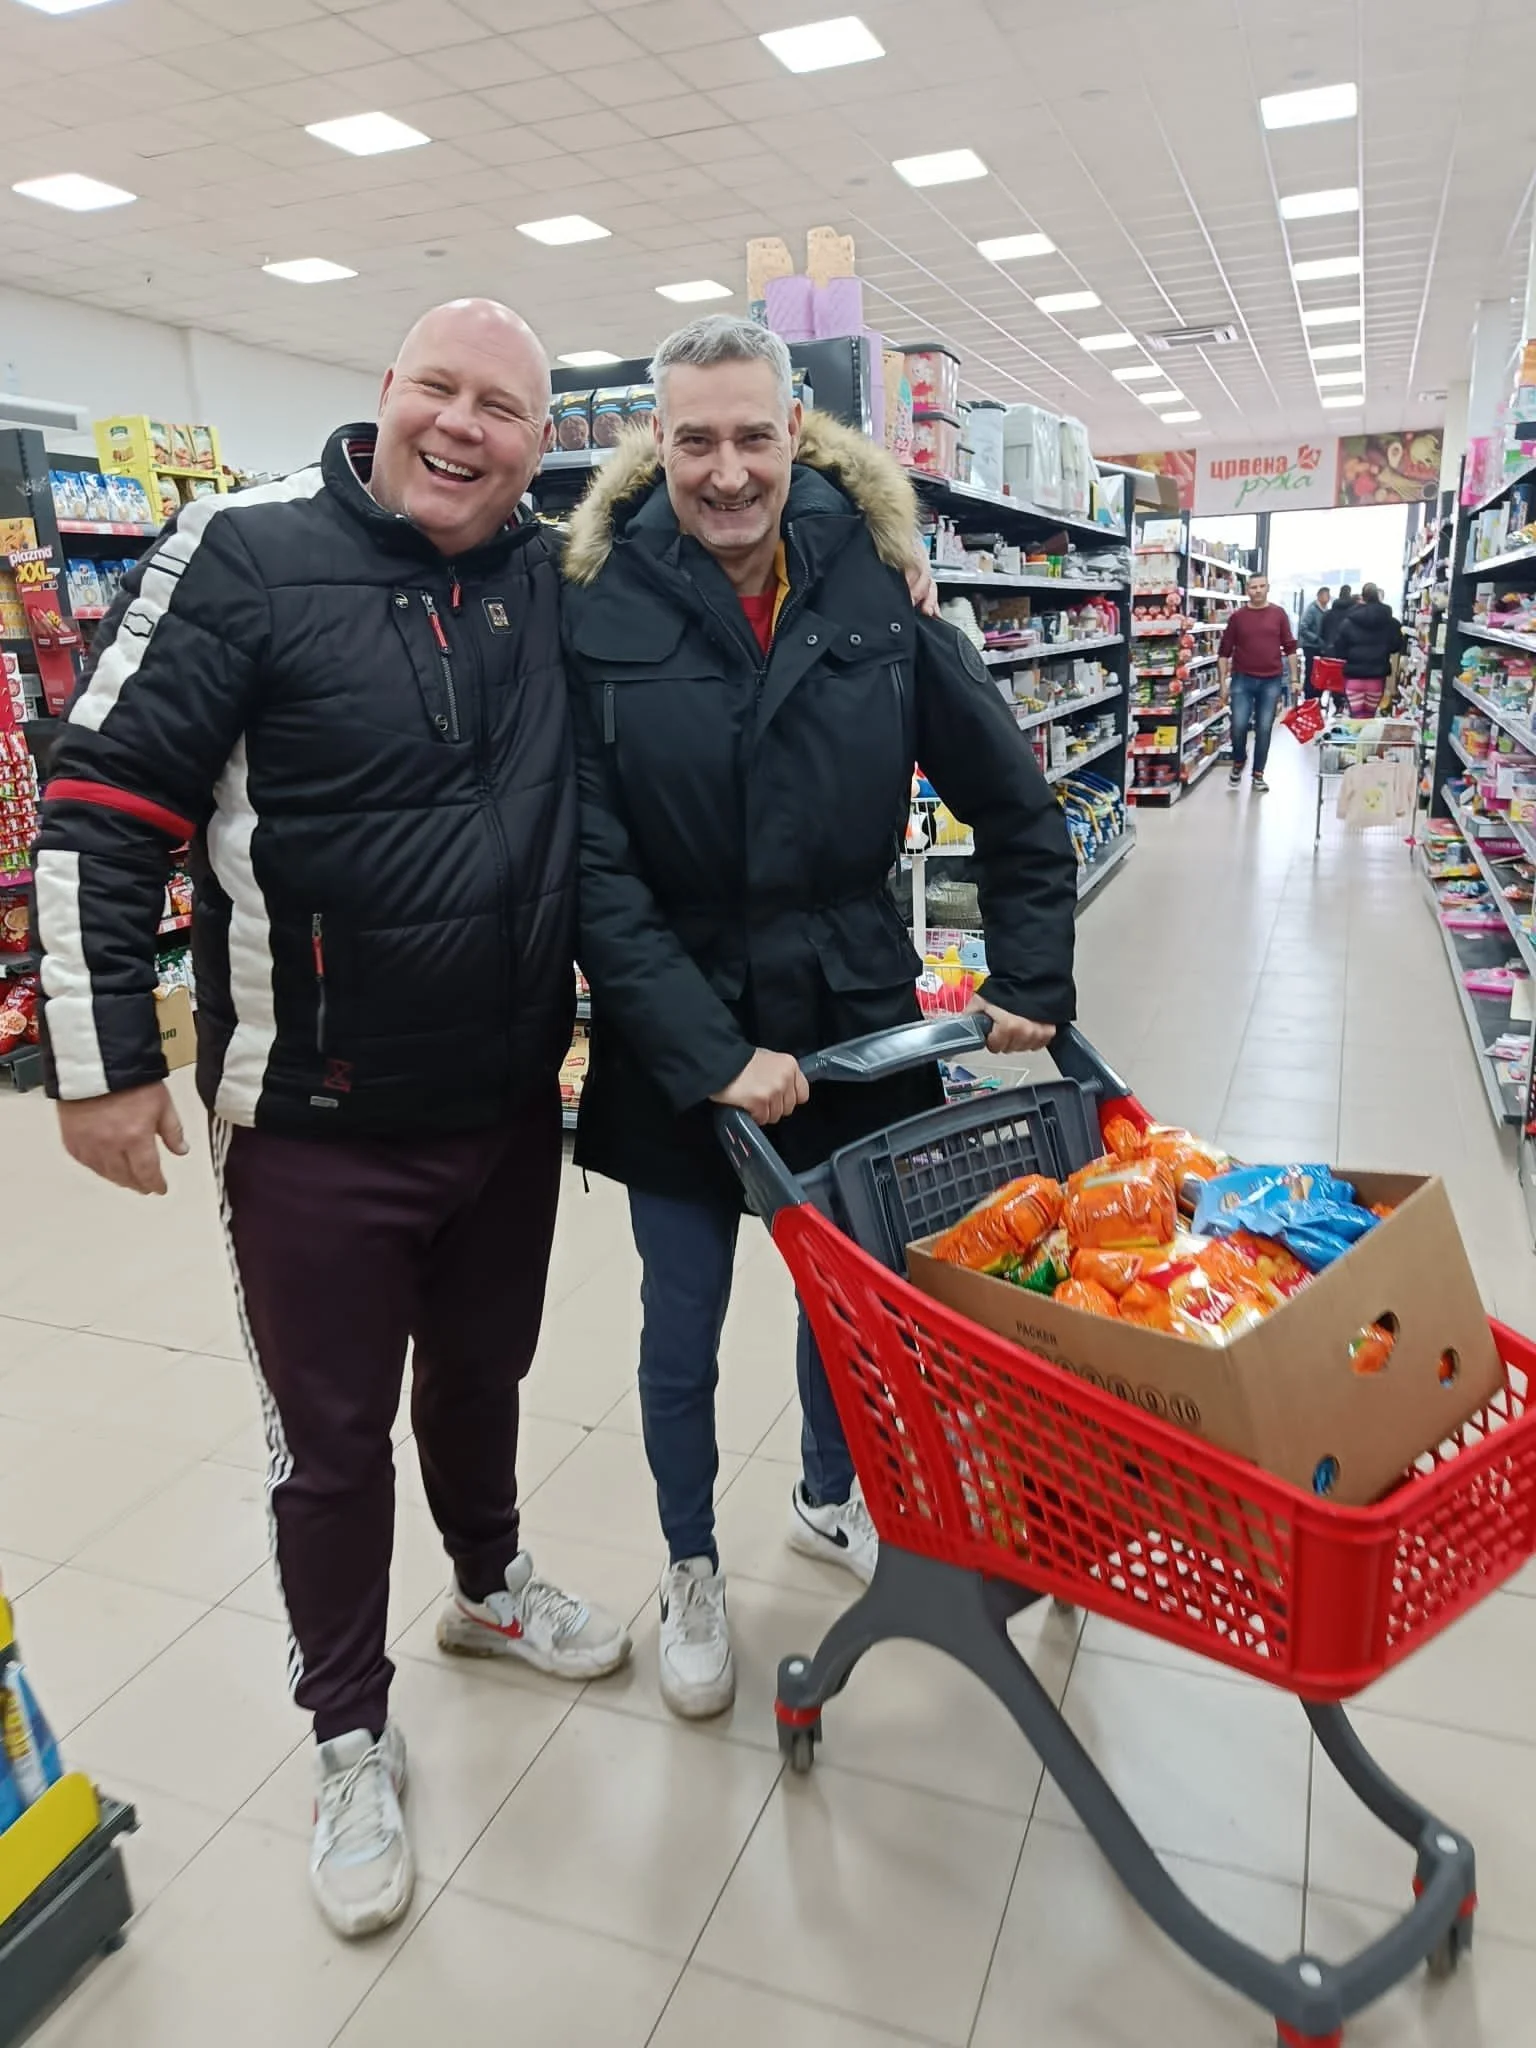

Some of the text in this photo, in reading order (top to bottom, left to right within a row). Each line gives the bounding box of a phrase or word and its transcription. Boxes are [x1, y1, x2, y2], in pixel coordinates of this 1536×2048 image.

[1210, 455, 1288, 480] црвена
[9, 547, 52, 567] plazma
[17, 562, 53, 583] XXL
[1175, 1398, 1198, 1422] 10
